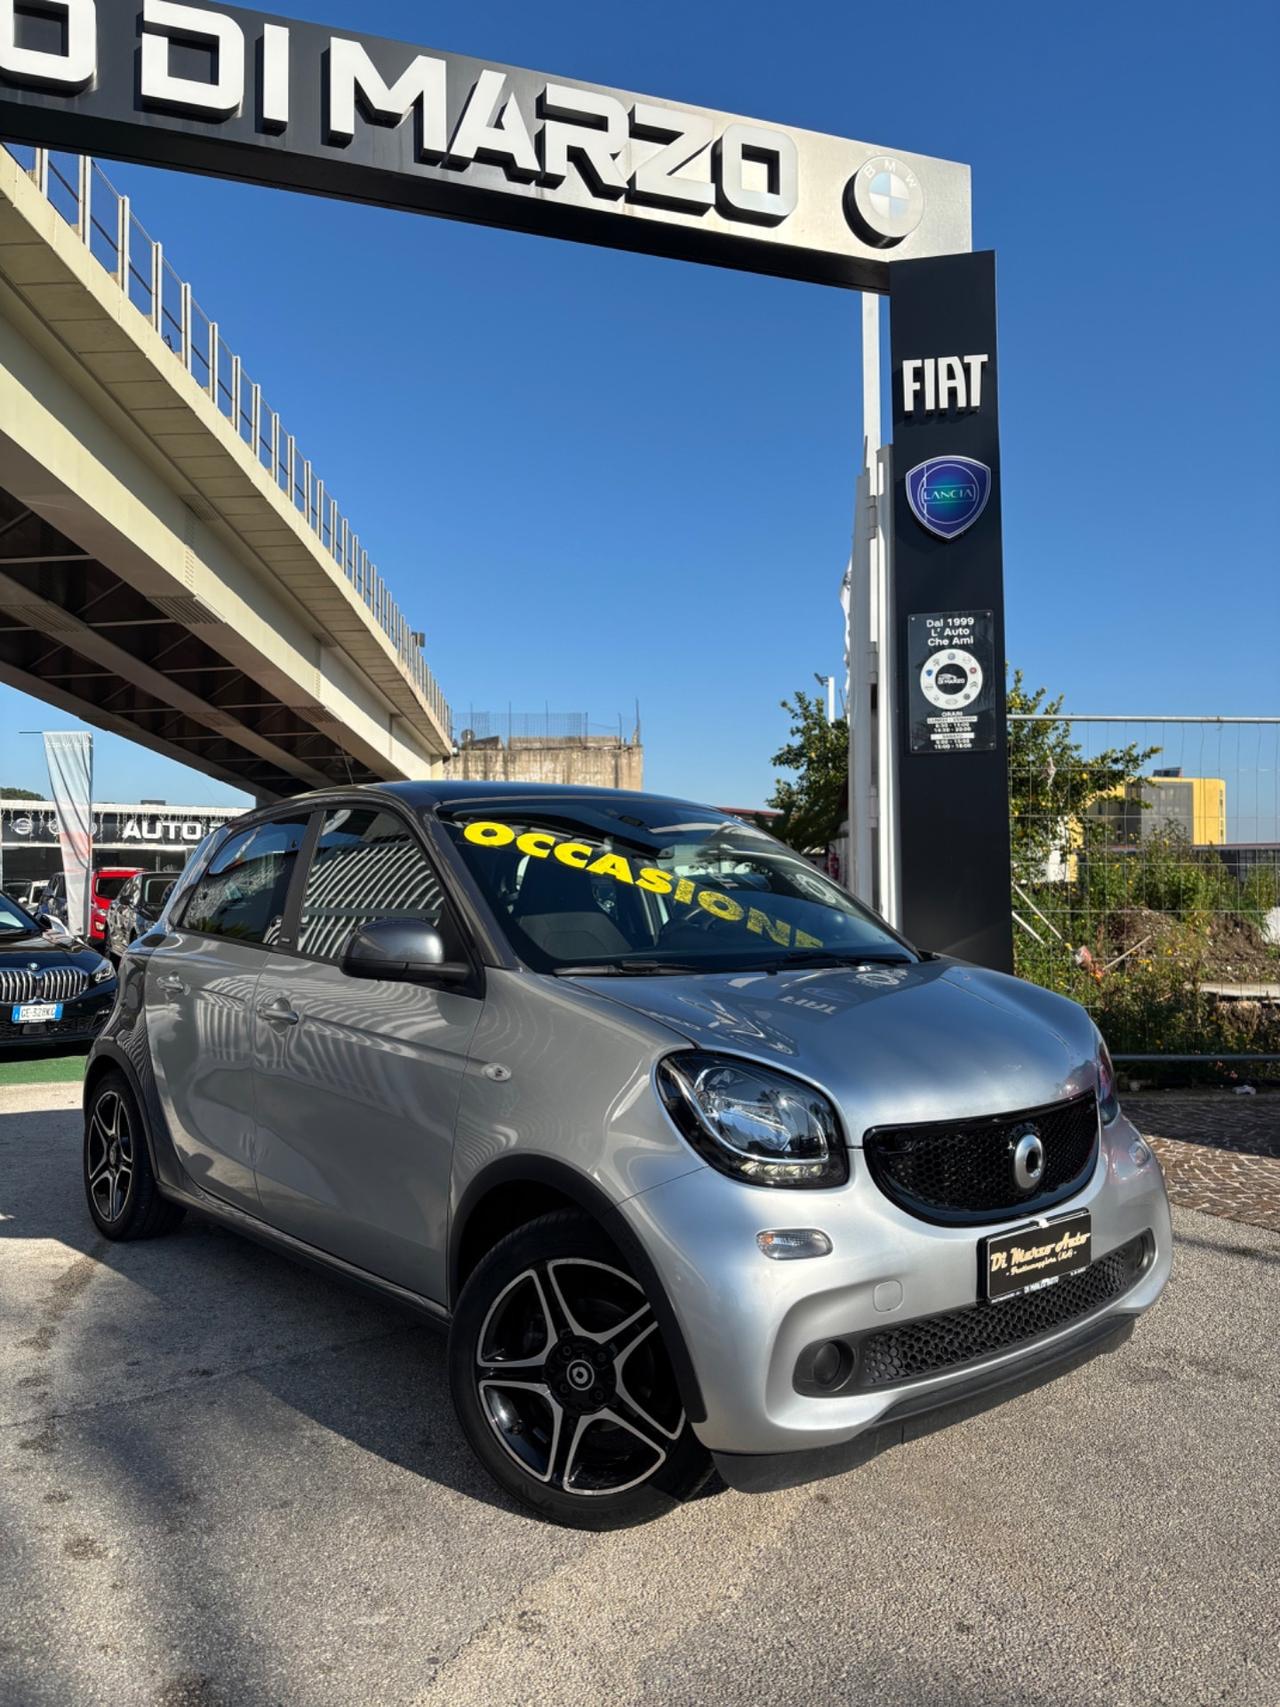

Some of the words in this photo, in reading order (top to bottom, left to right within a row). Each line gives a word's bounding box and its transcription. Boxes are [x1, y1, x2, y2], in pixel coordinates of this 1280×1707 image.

[142, 0, 289, 130] DI
[328, 36, 798, 218] MARZO
[864, 160, 916, 187] BMW
[902, 354, 988, 412] FIAT
[924, 487, 973, 500] LANCIA
[926, 619, 944, 628] Dal
[947, 617, 975, 627] 1999
[944, 627, 970, 636] Auto
[927, 637, 950, 647] Che
[952, 636, 974, 646] Ami
[122, 820, 201, 840] AUTO
[1055, 1232, 1092, 1253] Auto
